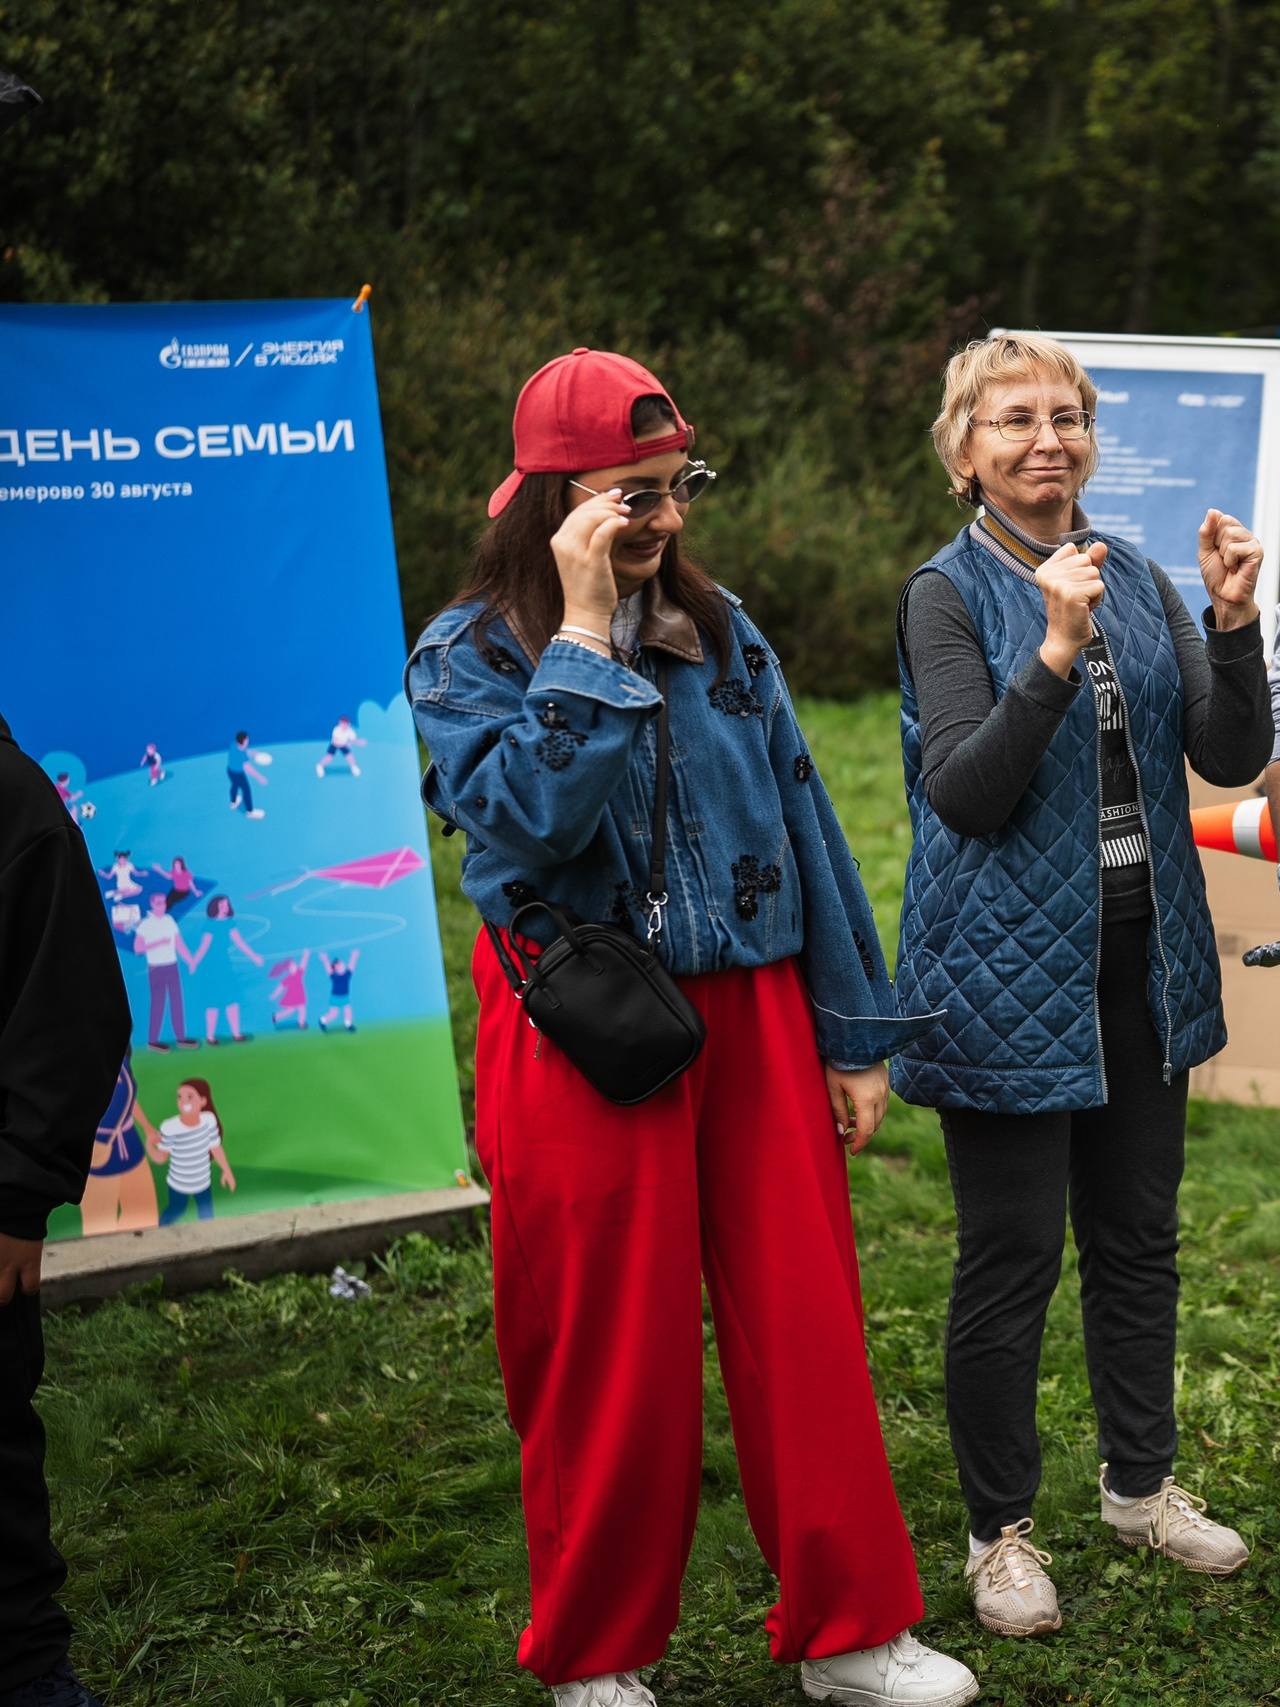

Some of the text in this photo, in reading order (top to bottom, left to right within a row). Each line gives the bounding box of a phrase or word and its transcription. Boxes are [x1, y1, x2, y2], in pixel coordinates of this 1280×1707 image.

[0, 418, 356, 467] ДЕНЬ СЕМЬИ
[0, 481, 193, 504] емерово 30 августа
[1100, 804, 1139, 819] ASHION
